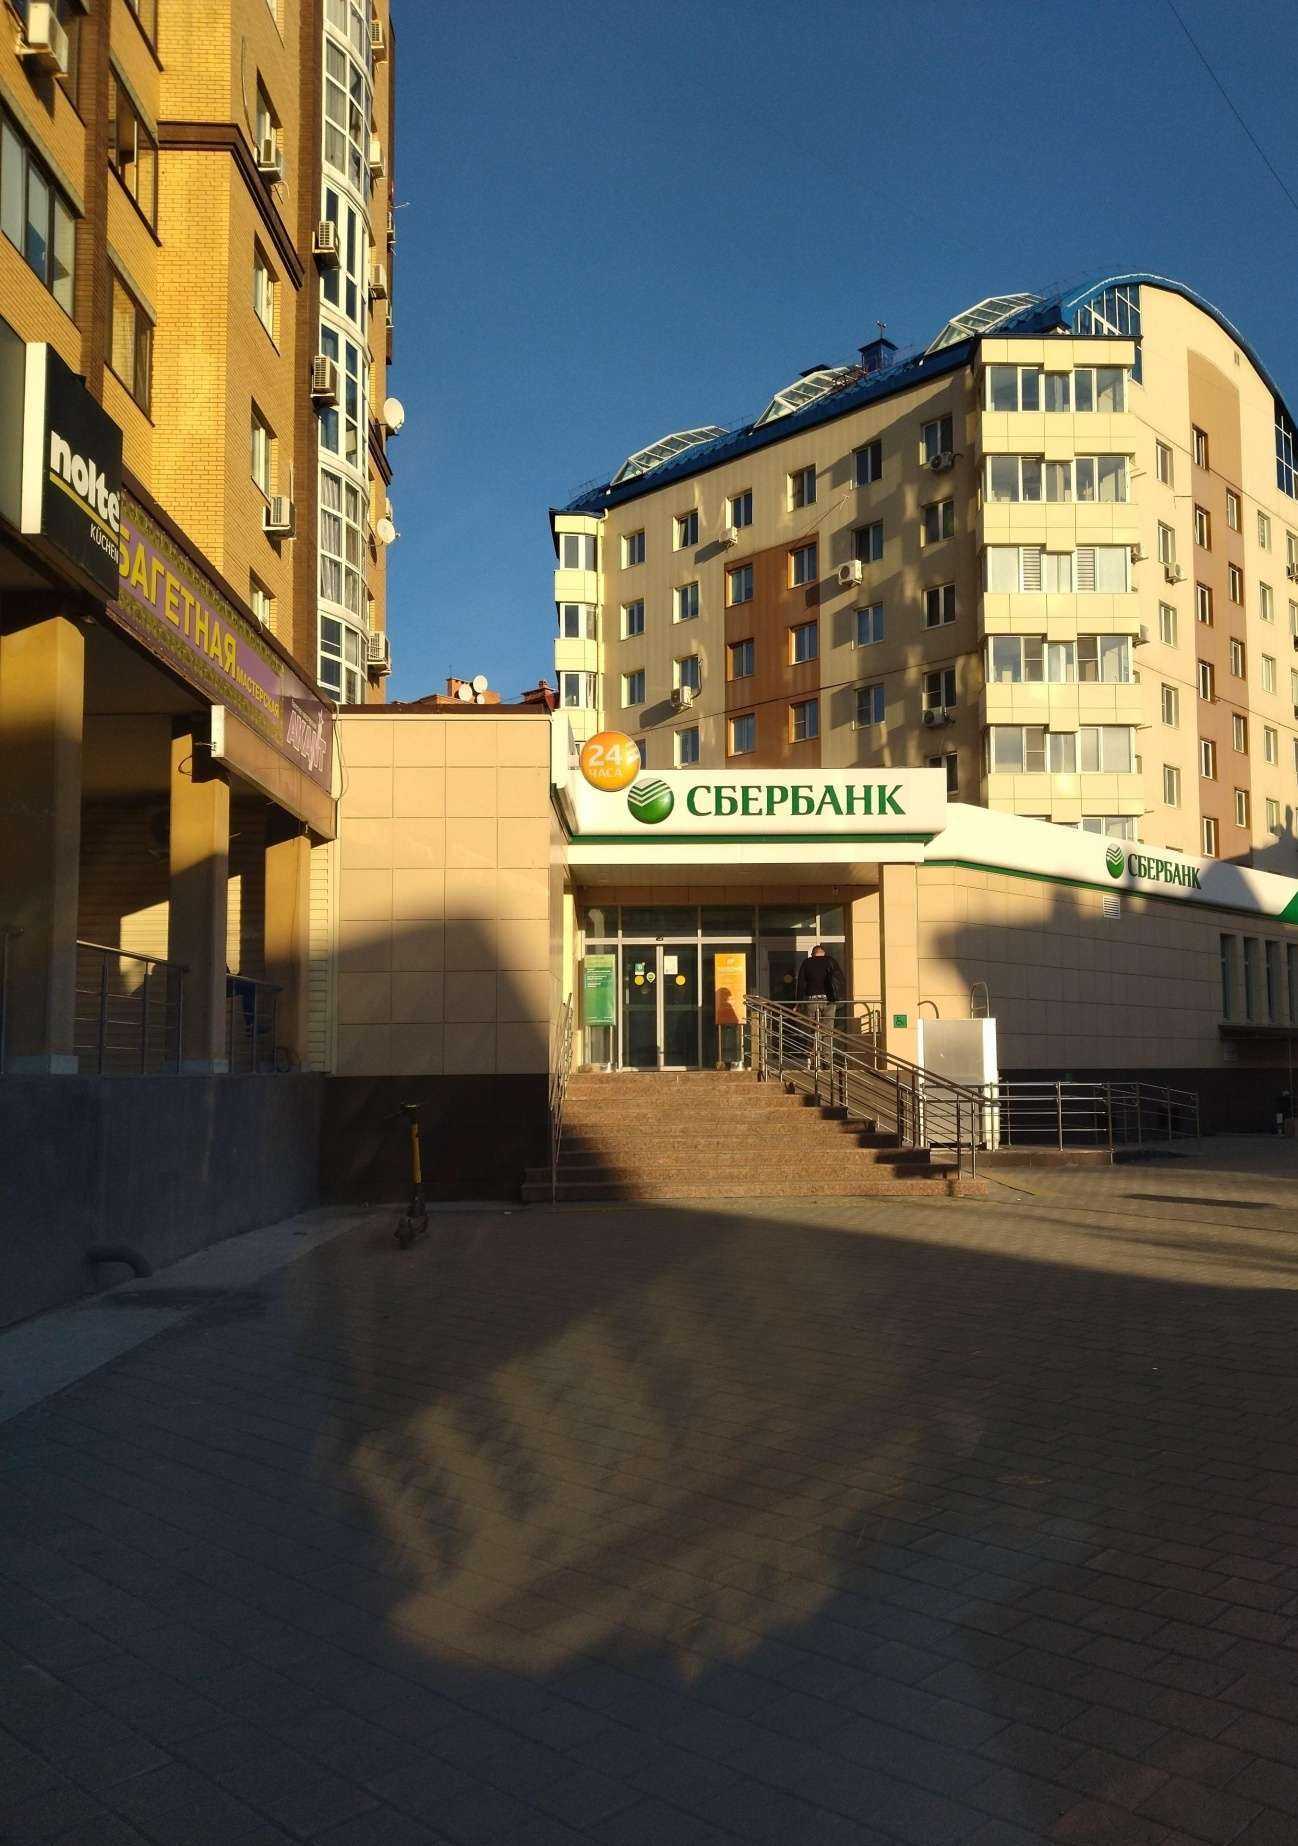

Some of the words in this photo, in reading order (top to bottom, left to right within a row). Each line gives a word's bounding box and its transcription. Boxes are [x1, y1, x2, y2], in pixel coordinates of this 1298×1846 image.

[50, 430, 120, 533] nolte
[588, 744, 622, 767] 24
[686, 784, 907, 817] СБЕРБАНК
[1127, 853, 1202, 890] СБЕРБАНК
